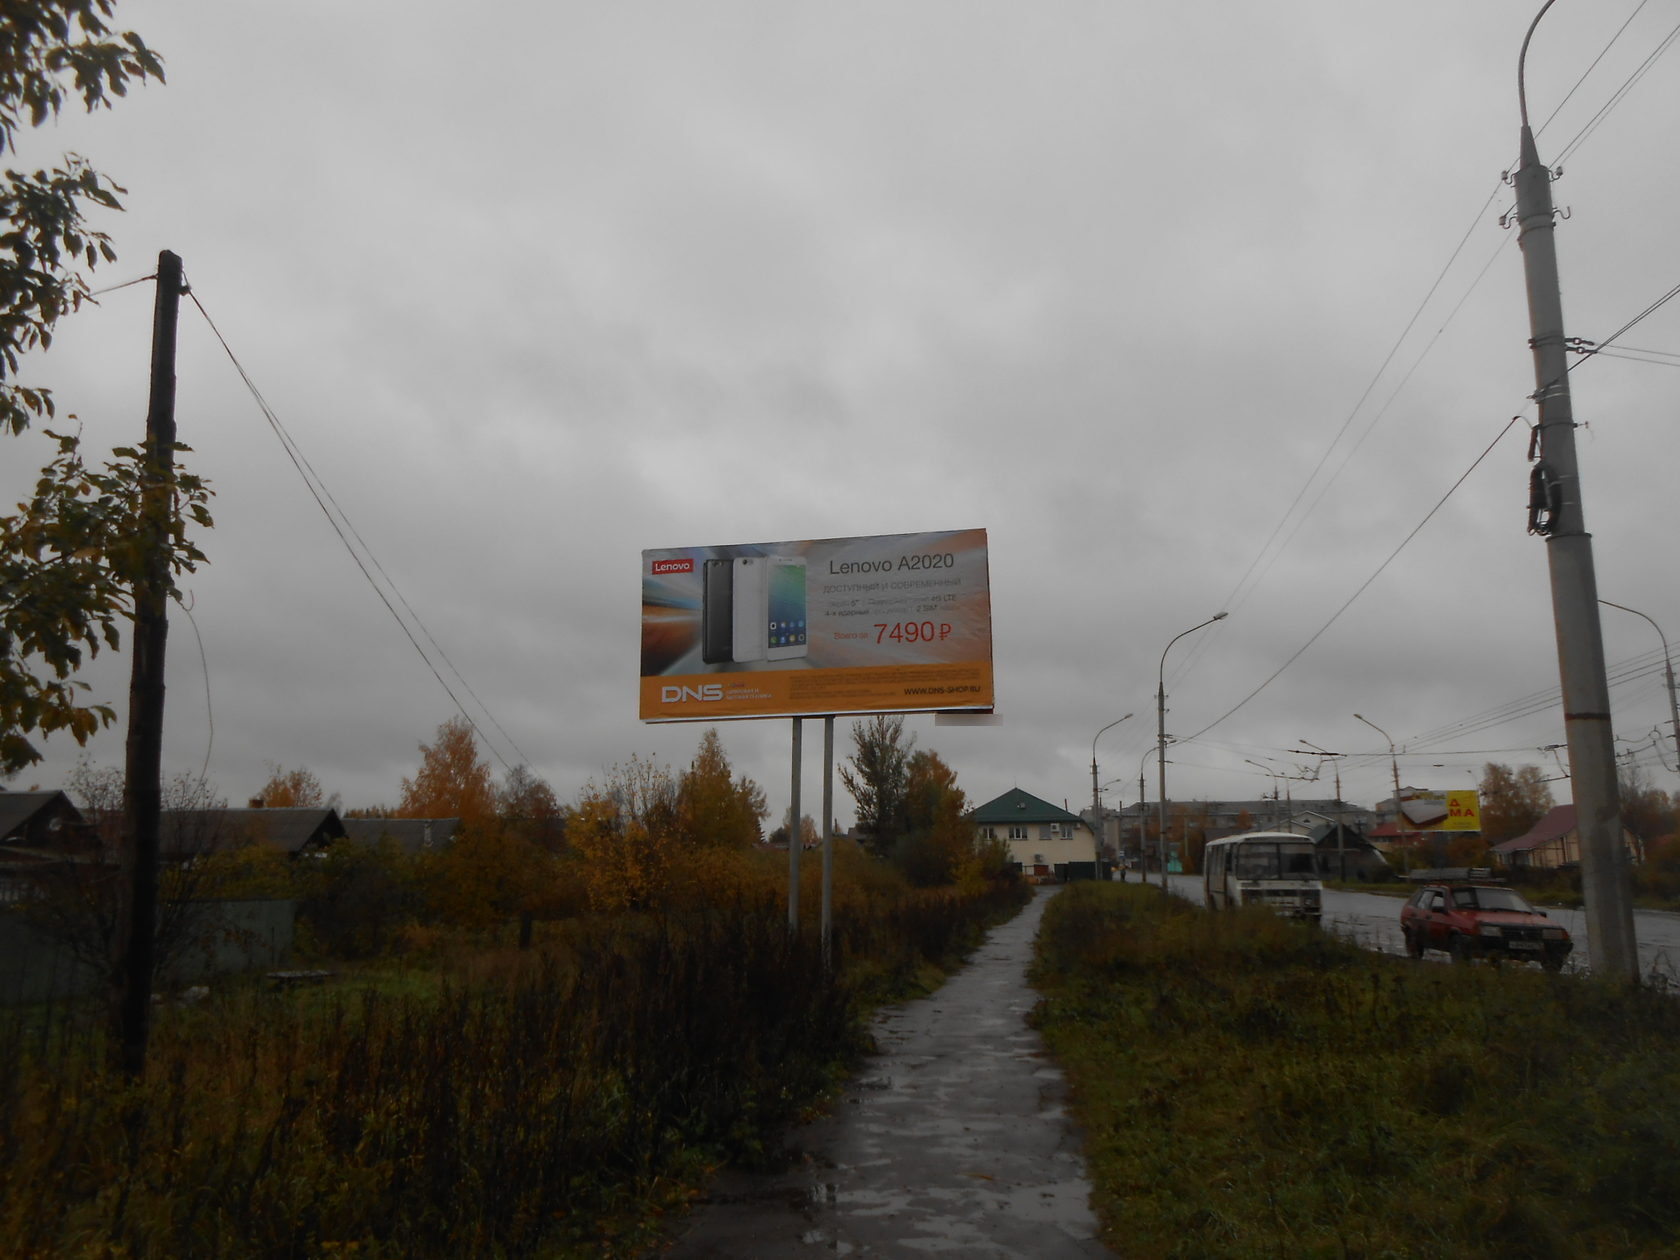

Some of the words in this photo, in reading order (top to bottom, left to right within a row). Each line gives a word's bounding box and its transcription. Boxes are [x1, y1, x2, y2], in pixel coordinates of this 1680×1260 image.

[655, 563, 691, 572] Lenovo
[829, 559, 893, 575] Lenovo
[897, 552, 955, 571] A2020
[661, 684, 724, 703] DNS
